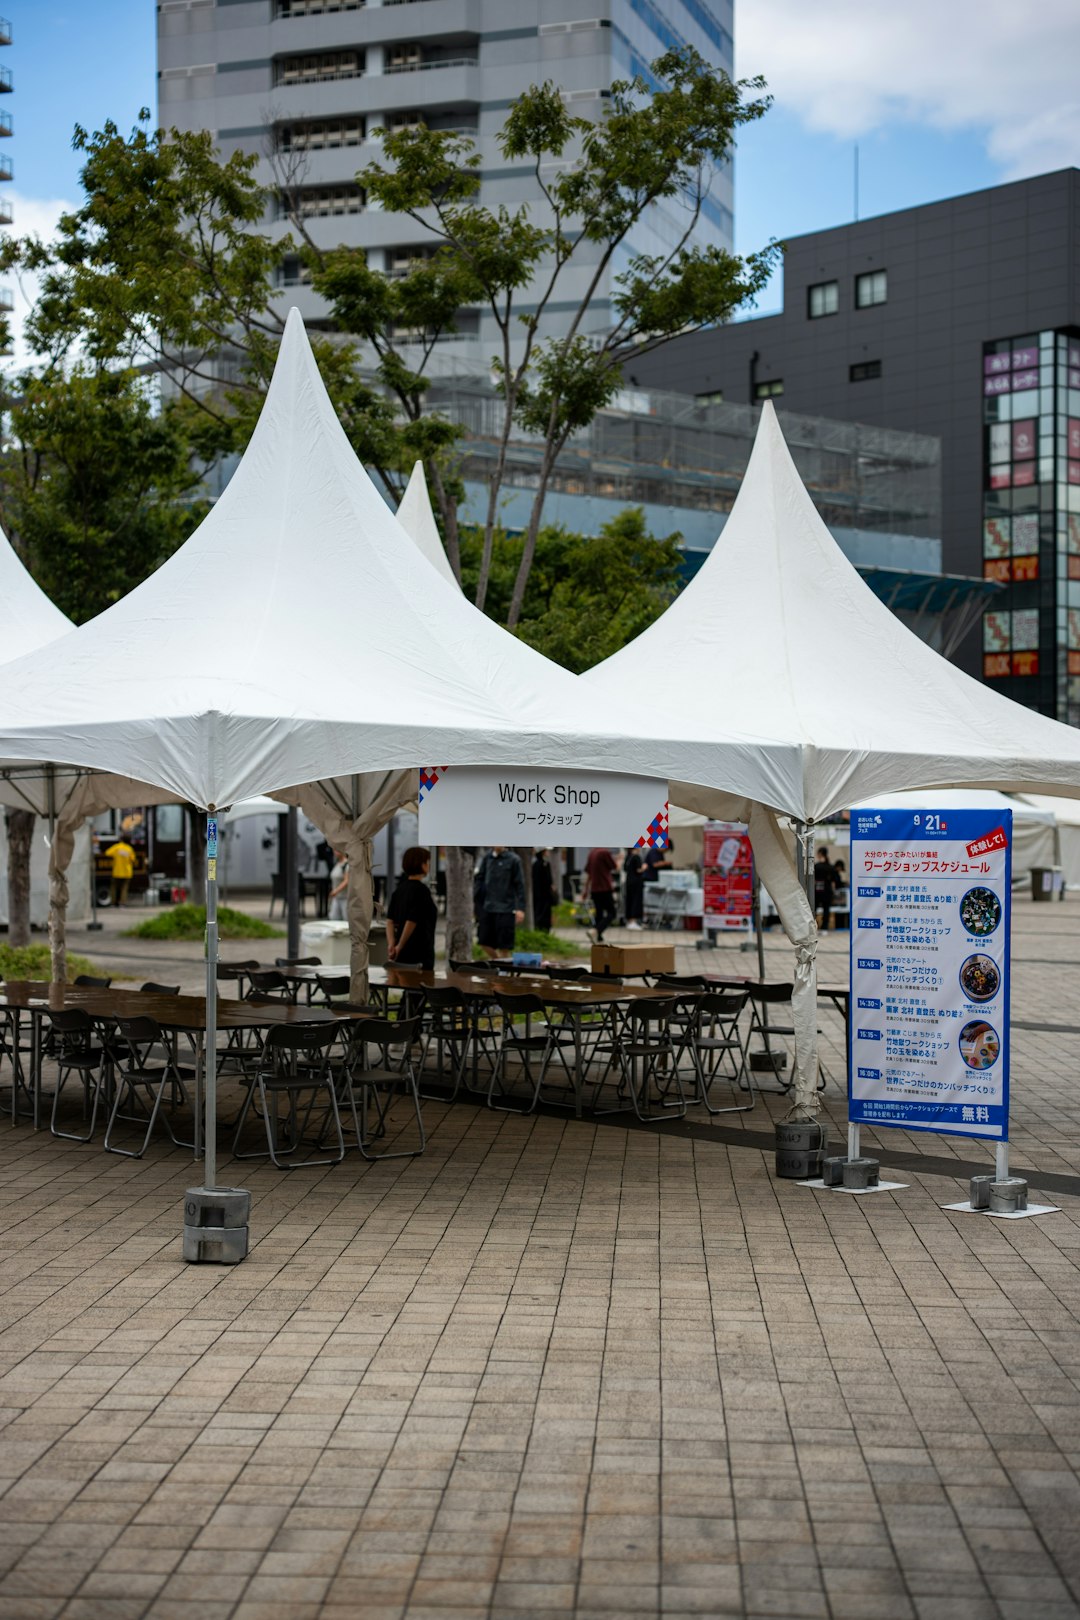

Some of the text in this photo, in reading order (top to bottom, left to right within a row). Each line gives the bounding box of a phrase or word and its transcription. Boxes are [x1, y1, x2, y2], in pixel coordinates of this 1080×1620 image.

[499, 783, 600, 807] Work Shop
[517, 813, 582, 826] ワークショップ
[865, 861, 990, 873] ワークショップスケジュール
[887, 965, 937, 974] 世界に一つだけの
[886, 1068, 925, 1077] 元気のでるアート
[962, 1106, 989, 1122] 無料
